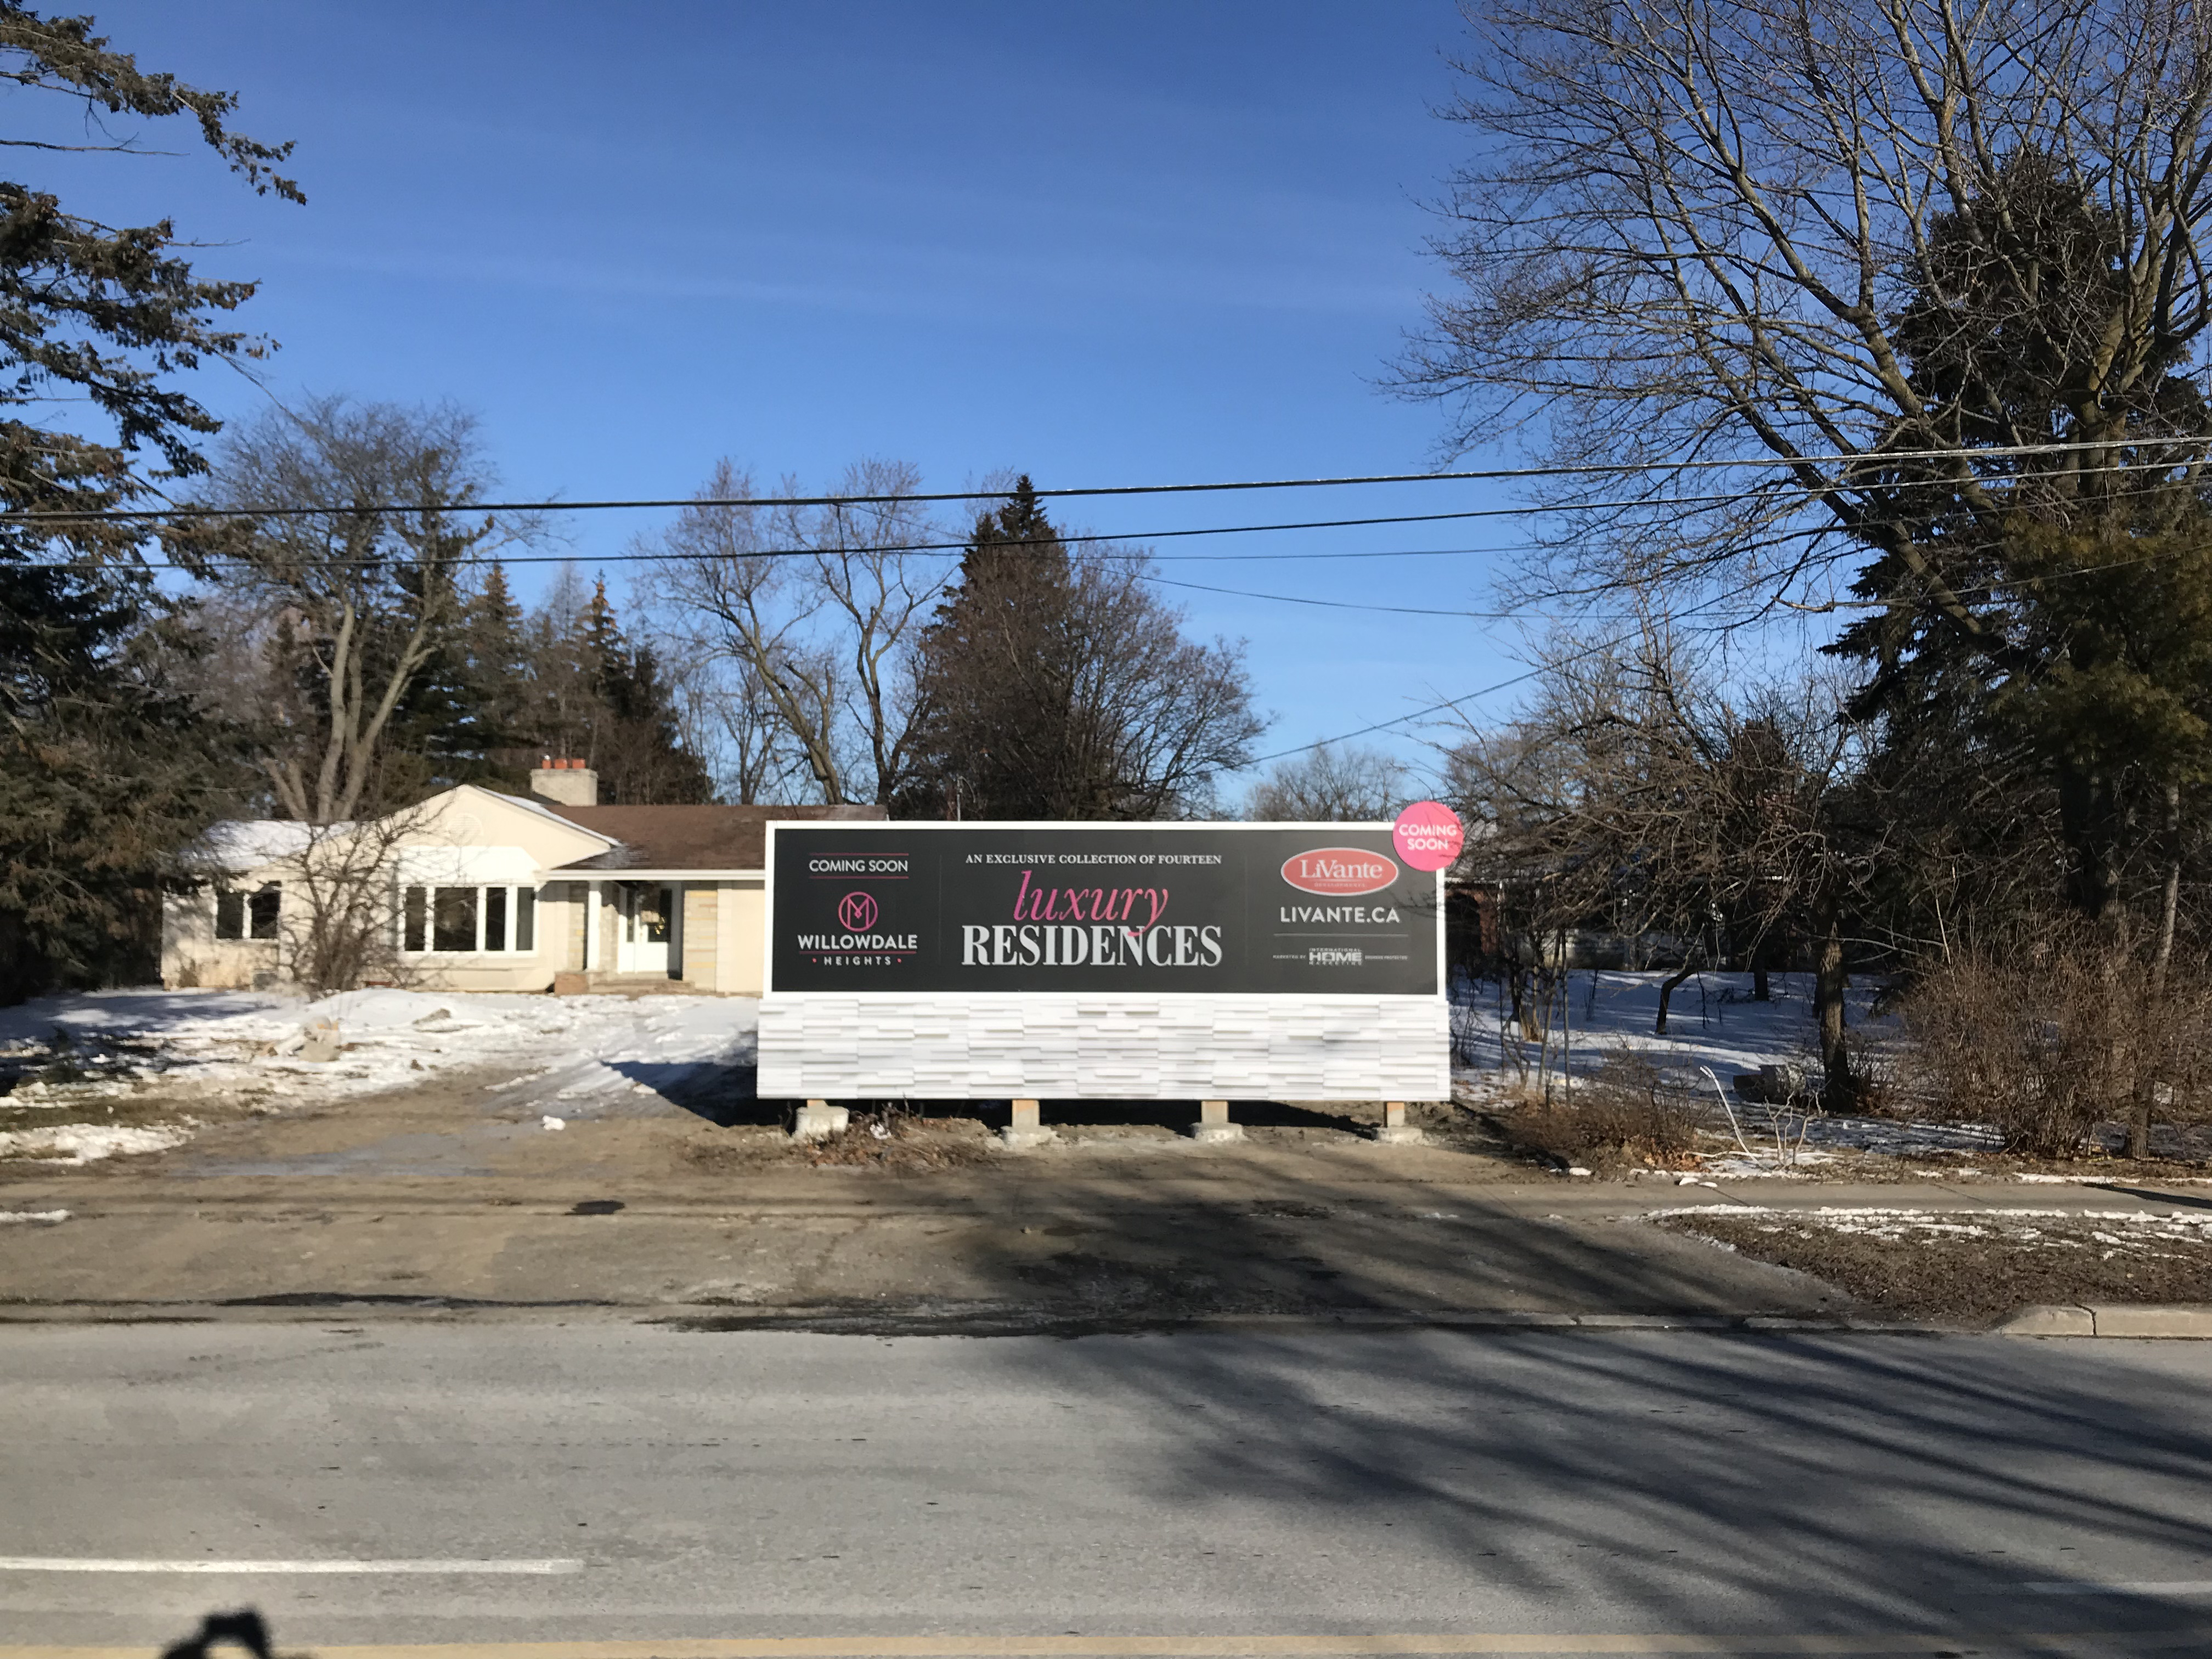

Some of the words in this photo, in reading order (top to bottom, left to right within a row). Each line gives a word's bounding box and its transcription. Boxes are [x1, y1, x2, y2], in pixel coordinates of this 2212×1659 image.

[1398, 824, 1457, 837] COMING
[1407, 838, 1448, 851] SOON
[809, 859, 866, 872] COMING
[868, 860, 909, 872] SOON
[966, 854, 983, 864] AN
[986, 854, 1056, 864] EXCLUSIVE
[1059, 854, 1137, 864] COLLECTION
[1139, 855, 1156, 864] OF
[1158, 855, 1222, 865] FOURTEEN
[1299, 859, 1383, 879] LiVante
[1013, 870, 1169, 938] luxury
[1280, 906, 1401, 923] LIVANTE.CA
[797, 934, 918, 950] WILLOWDALE
[961, 924, 1223, 967] RESIDENCES
[824, 956, 891, 966] HEIGHTS
[1309, 952, 1362, 962] HOME
